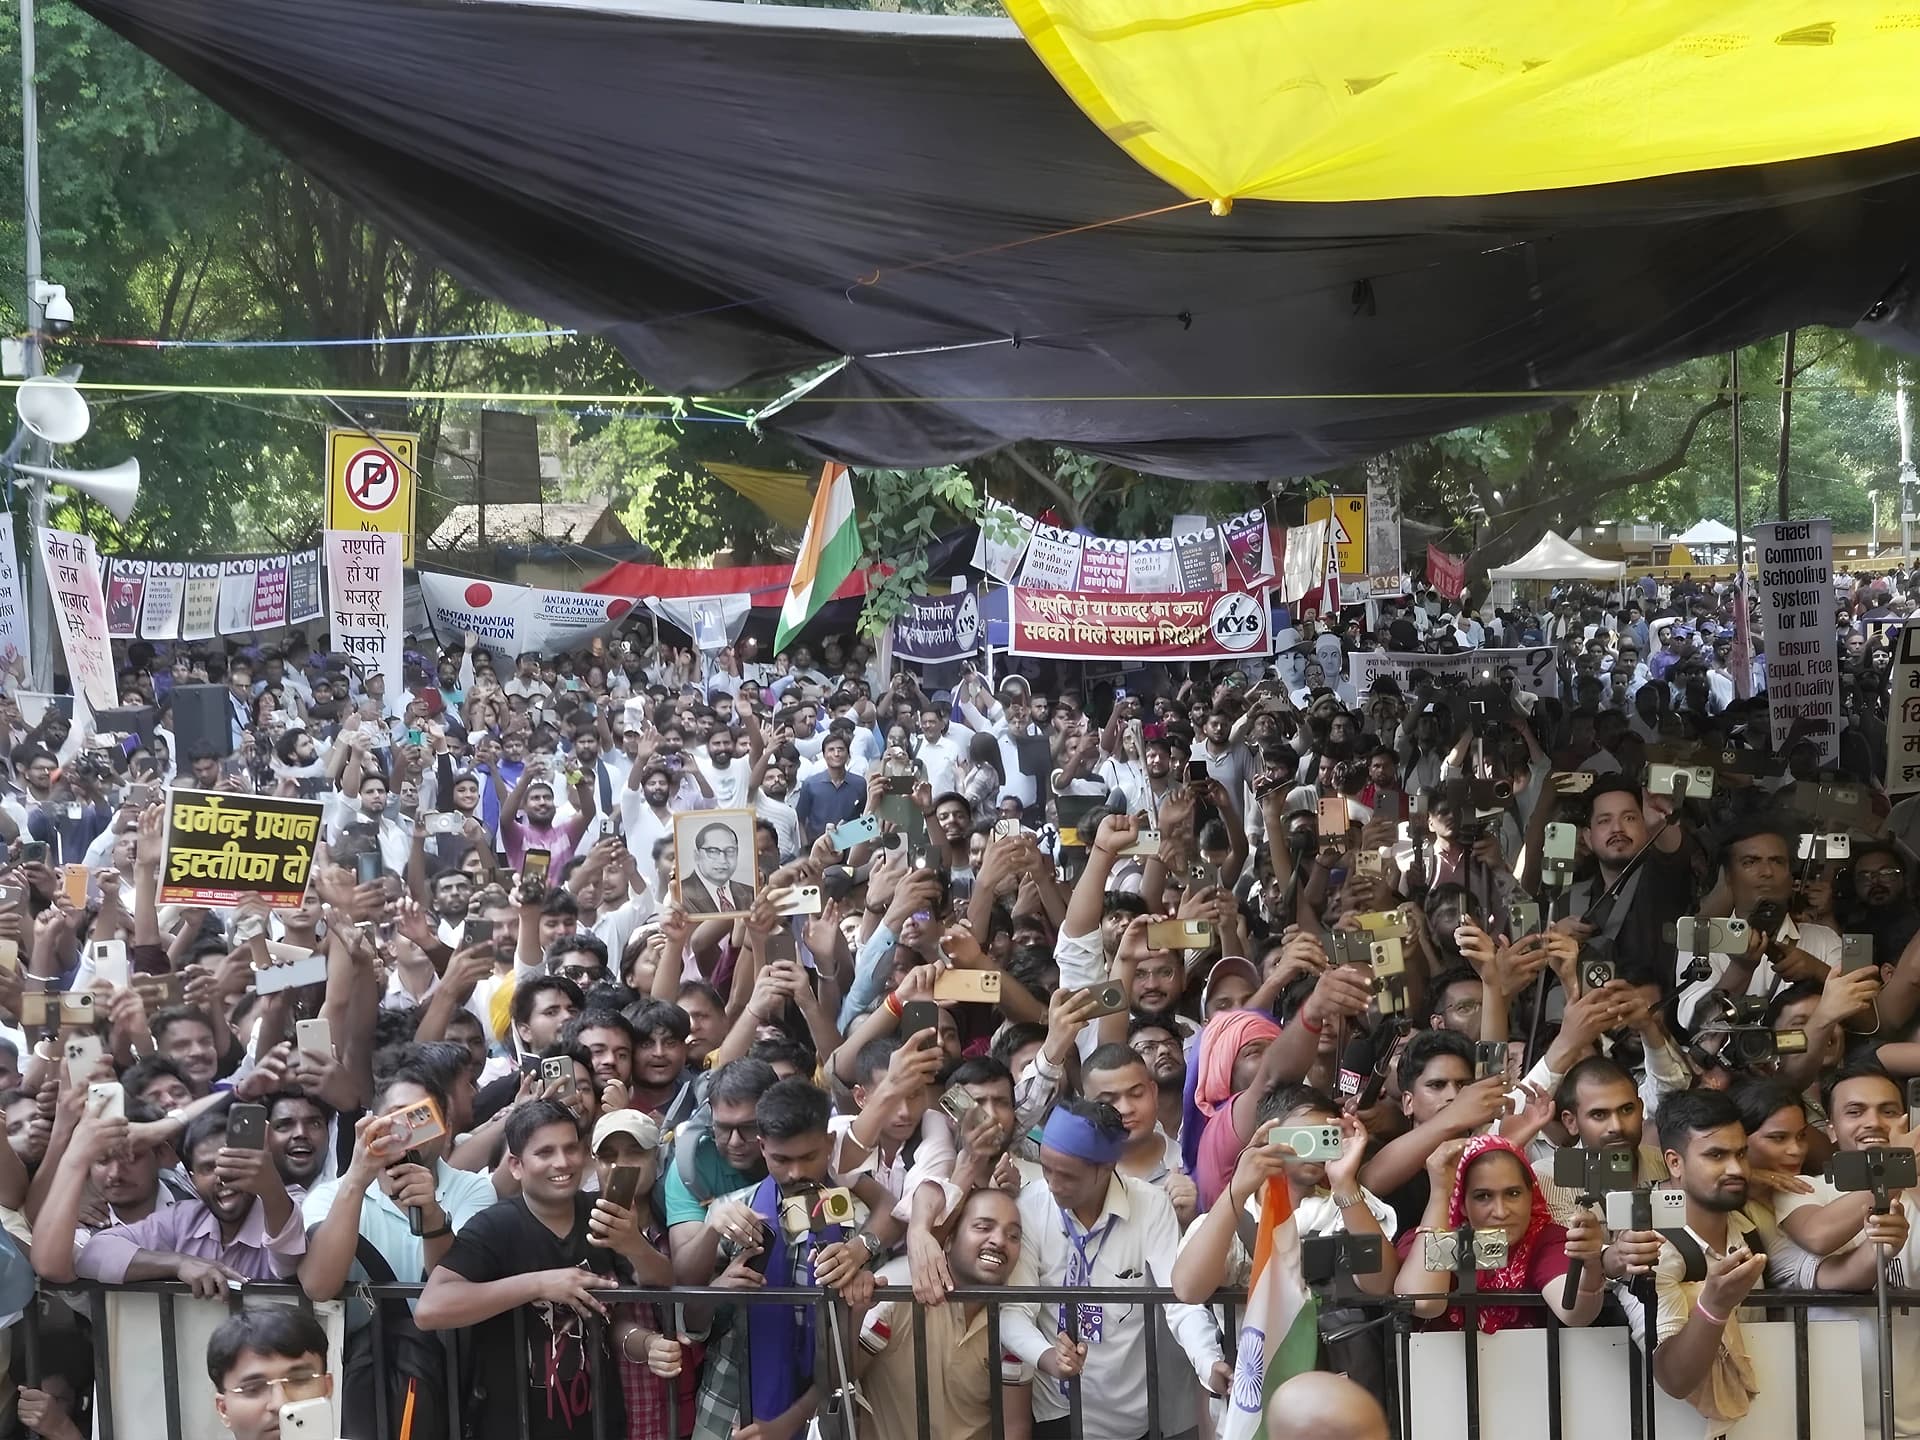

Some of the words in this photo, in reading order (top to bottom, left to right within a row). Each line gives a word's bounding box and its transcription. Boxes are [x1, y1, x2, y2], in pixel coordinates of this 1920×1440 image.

[1222, 508, 1263, 535] KYS
[1037, 523, 1081, 547] KYS
[1177, 527, 1215, 547] KYS
[1775, 523, 1810, 541] Enact
[1085, 536, 1128, 553] KYS
[1130, 538, 1172, 554] KYS
[1765, 545, 1822, 564] Common
[112, 559, 146, 575] KYS
[152, 562, 184, 577] KYS
[190, 562, 219, 578] KYS
[226, 559, 254, 575] KYS
[346, 562, 361, 583] हो
[363, 566, 380, 582] या
[1763, 566, 1827, 586] Schooling
[1370, 576, 1399, 589] KYS
[344, 589, 382, 611] मजदूर
[1772, 590, 1820, 609] System
[336, 611, 352, 628] का
[473, 614, 514, 628] MANTAR
[1217, 615, 1259, 634] KYS
[1778, 613, 1796, 630] for
[1023, 617, 1070, 642] सबको
[1072, 619, 1107, 644] मिले
[340, 629, 387, 653] सबको
[1808, 660, 1832, 675] Free
[173, 796, 252, 840] धर्मेन्द्र
[254, 811, 319, 842] प्रधान
[170, 841, 279, 883] इस्तीफा
[282, 845, 311, 884] दो
